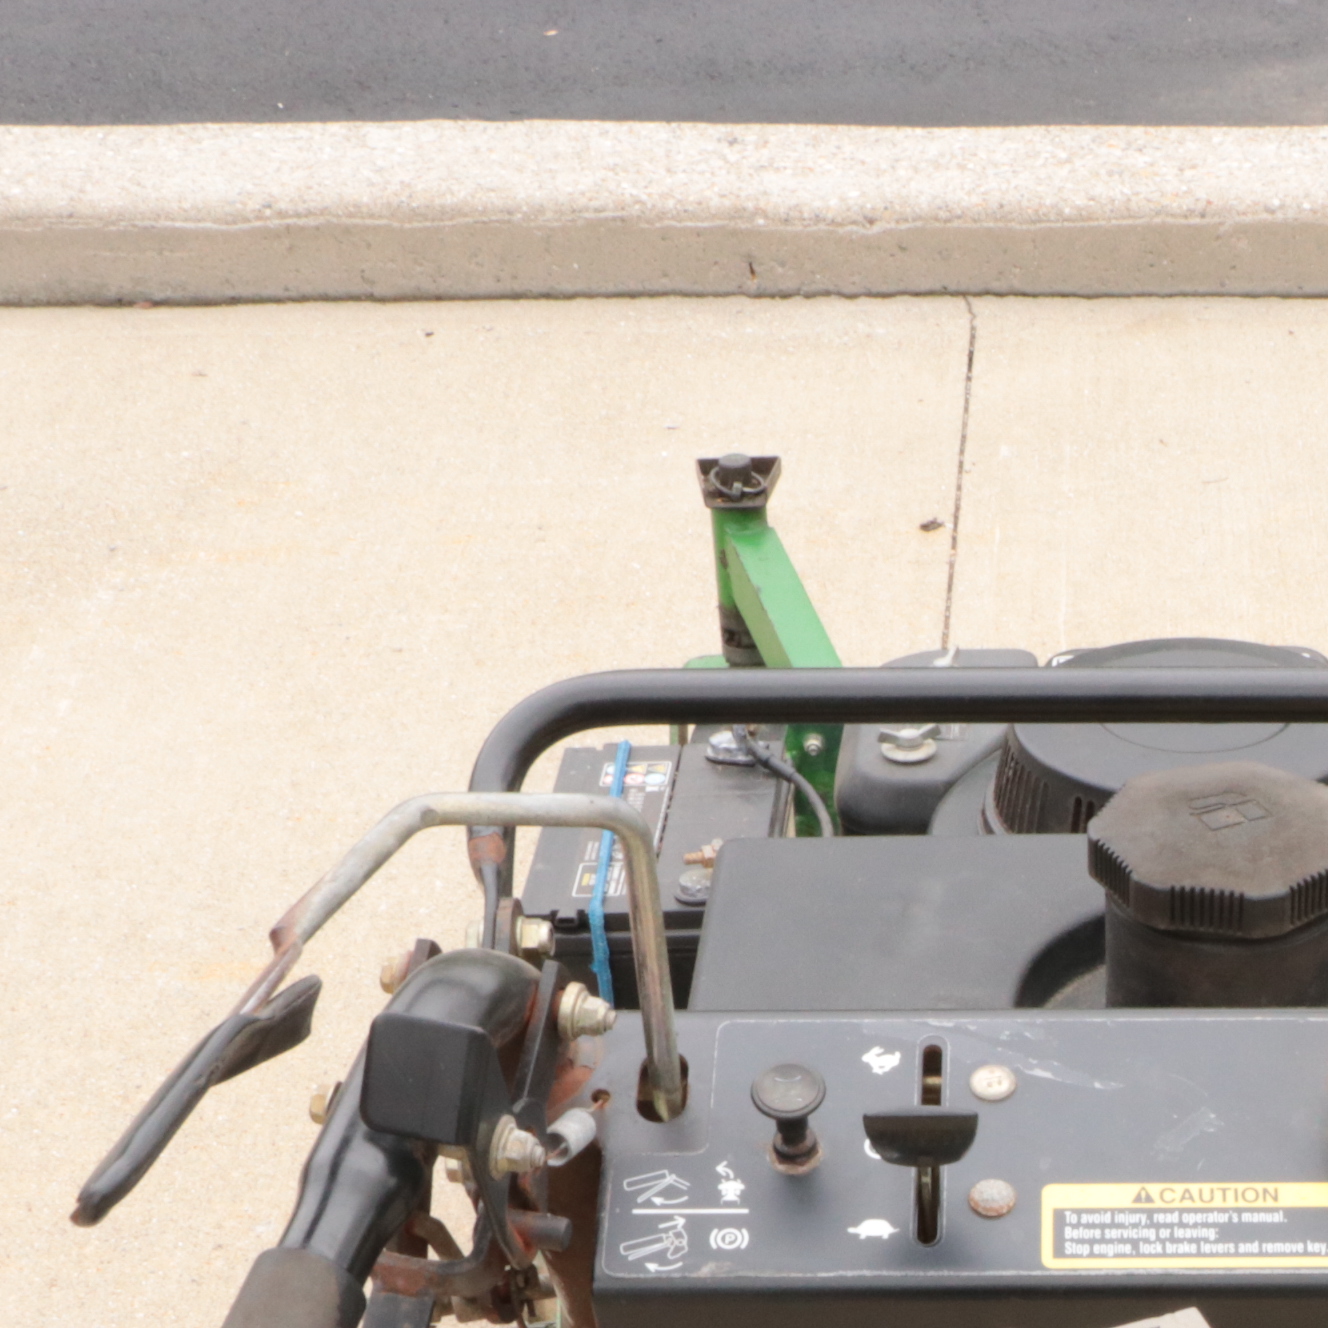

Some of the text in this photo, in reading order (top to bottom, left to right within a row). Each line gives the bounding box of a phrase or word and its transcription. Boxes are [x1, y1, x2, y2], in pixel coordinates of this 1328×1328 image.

[1159, 1187, 1279, 1204] CAUTION
[1064, 1210, 1288, 1226] To avoid injury, read operator's manual.
[1064, 1226, 1220, 1241] Before servicing or leaving:
[1064, 1241, 1091, 1257] Stop
[1093, 1242, 1136, 1257] engine,
[1139, 1241, 1163, 1254] lock
[1165, 1241, 1198, 1254] brake
[1200, 1240, 1236, 1254] levers
[1238, 1240, 1260, 1253] and
[1262, 1241, 1305, 1253] remove
